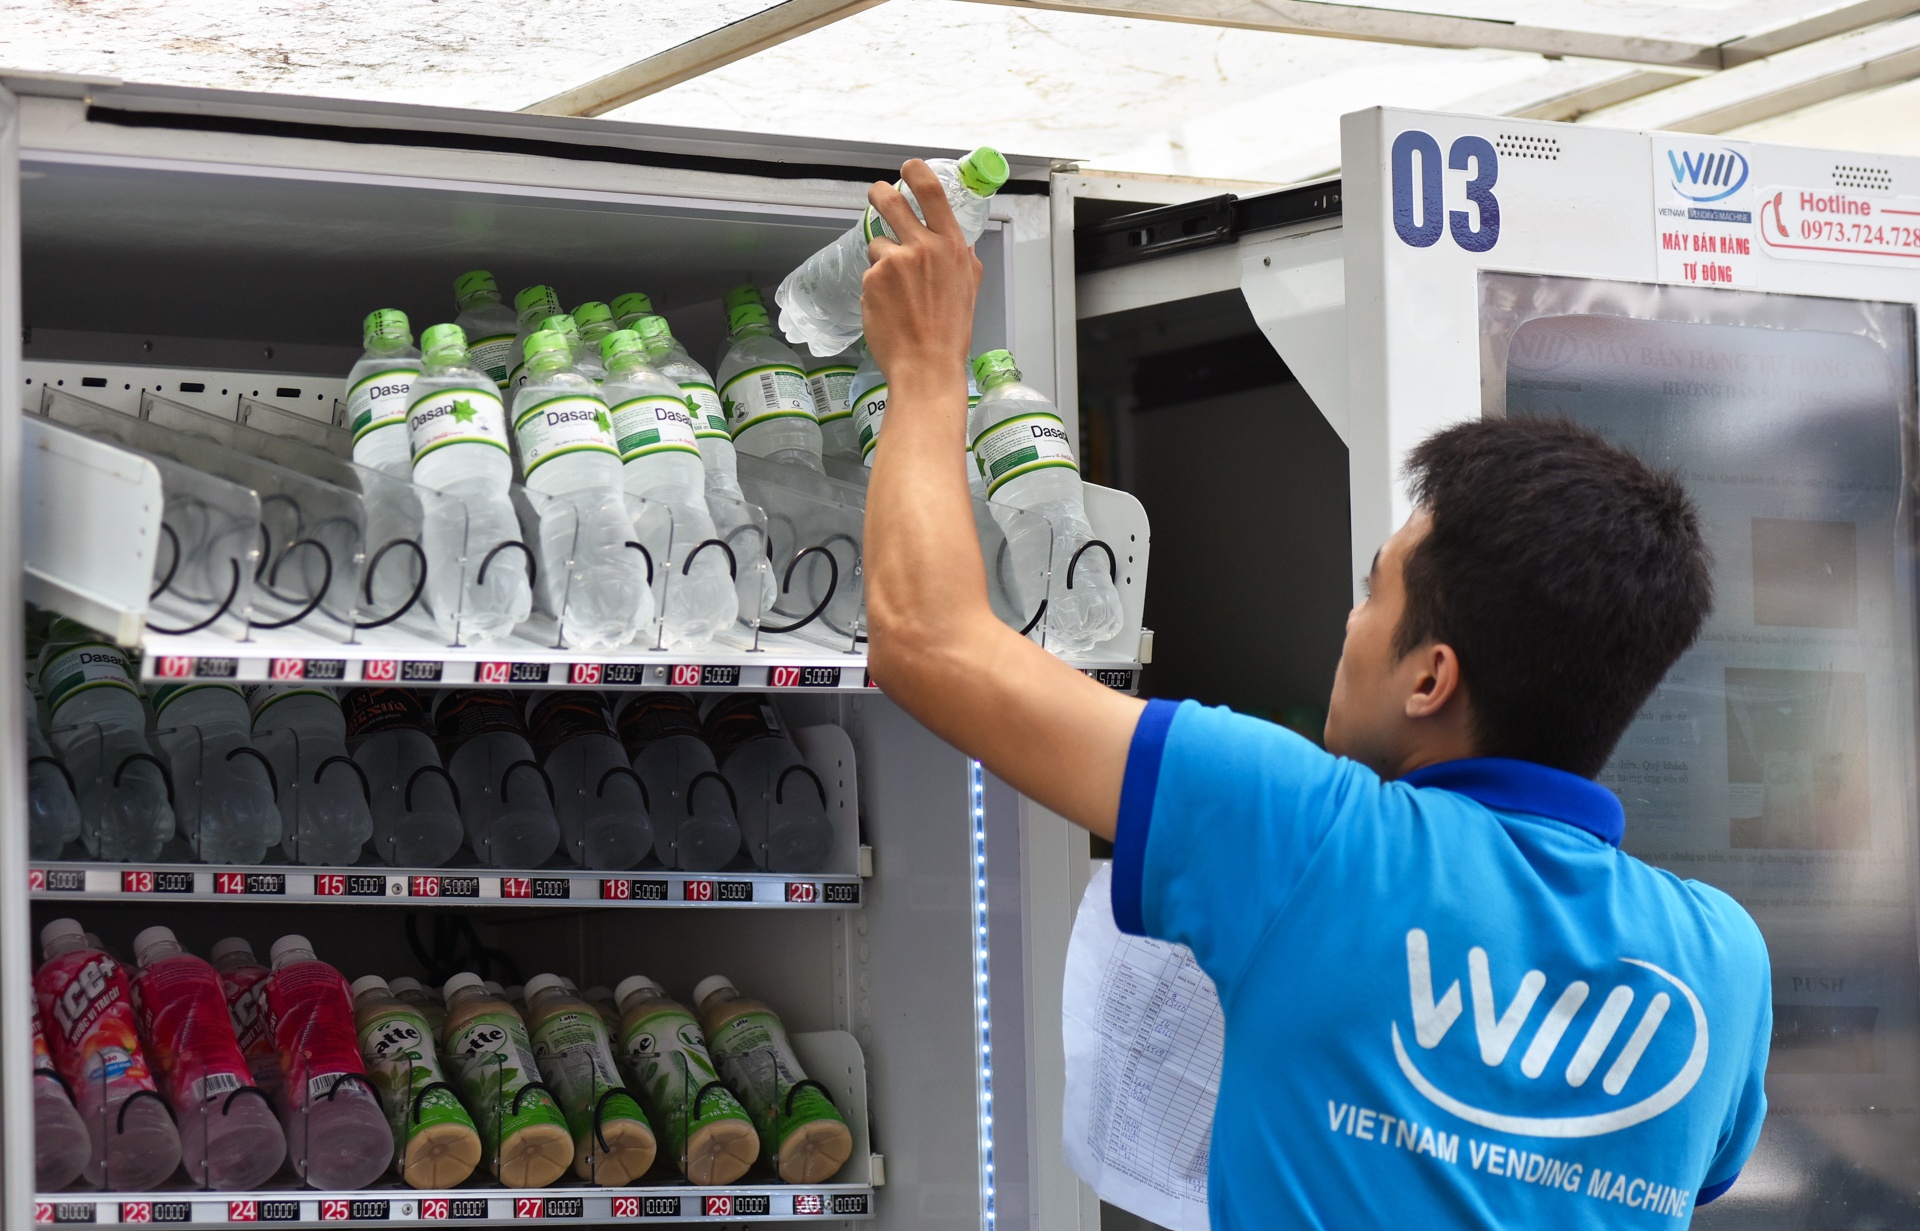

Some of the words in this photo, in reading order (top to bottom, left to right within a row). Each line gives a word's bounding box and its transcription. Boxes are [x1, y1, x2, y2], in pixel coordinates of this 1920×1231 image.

[1391, 129, 1501, 253] 03
[1800, 191, 1872, 216] Hotline
[1658, 207, 1686, 219] VIETNAM
[1689, 208, 1718, 221] VENDING
[1718, 211, 1749, 223] MACHINE
[1662, 231, 1689, 250] MÁY
[1693, 232, 1717, 253] BÁN
[1720, 234, 1750, 255] HÀNG
[1683, 262, 1698, 284] TỰ
[1702, 261, 1732, 285] ĐỘNG
[369, 383, 410, 400] Dasa
[411, 400, 458, 432] Dasani
[547, 408, 600, 426] Dasani
[655, 408, 692, 426] Dasan
[1030, 425, 1067, 441] Dasan
[80, 652, 124, 666] Dasan
[165, 657, 190, 678] 01
[275, 658, 302, 679] 02
[368, 660, 395, 679] 03
[482, 663, 507, 683] 04
[574, 663, 600, 684] 05
[674, 664, 699, 685] 06
[774, 666, 799, 687] 07
[31, 871, 43, 891] 2
[128, 872, 152, 892] 13
[219, 874, 243, 894] 14
[320, 876, 344, 896] 15
[415, 876, 439, 896] 16
[507, 878, 529, 897] 17
[607, 879, 629, 899] 18
[689, 881, 711, 900] 19
[791, 883, 814, 902] 20
[374, 1027, 419, 1054] atte
[464, 1029, 504, 1058] atte
[1328, 1100, 1460, 1164] VIETNAM
[1468, 1139, 1583, 1192] VENDING
[1586, 1168, 1690, 1219] MACHINE
[126, 1203, 150, 1223] 23
[231, 1201, 256, 1220] 24
[324, 1201, 348, 1220] 25
[424, 1200, 447, 1219] 26
[518, 1199, 542, 1218] 27
[615, 1198, 638, 1217] 28
[708, 1197, 731, 1216] 29
